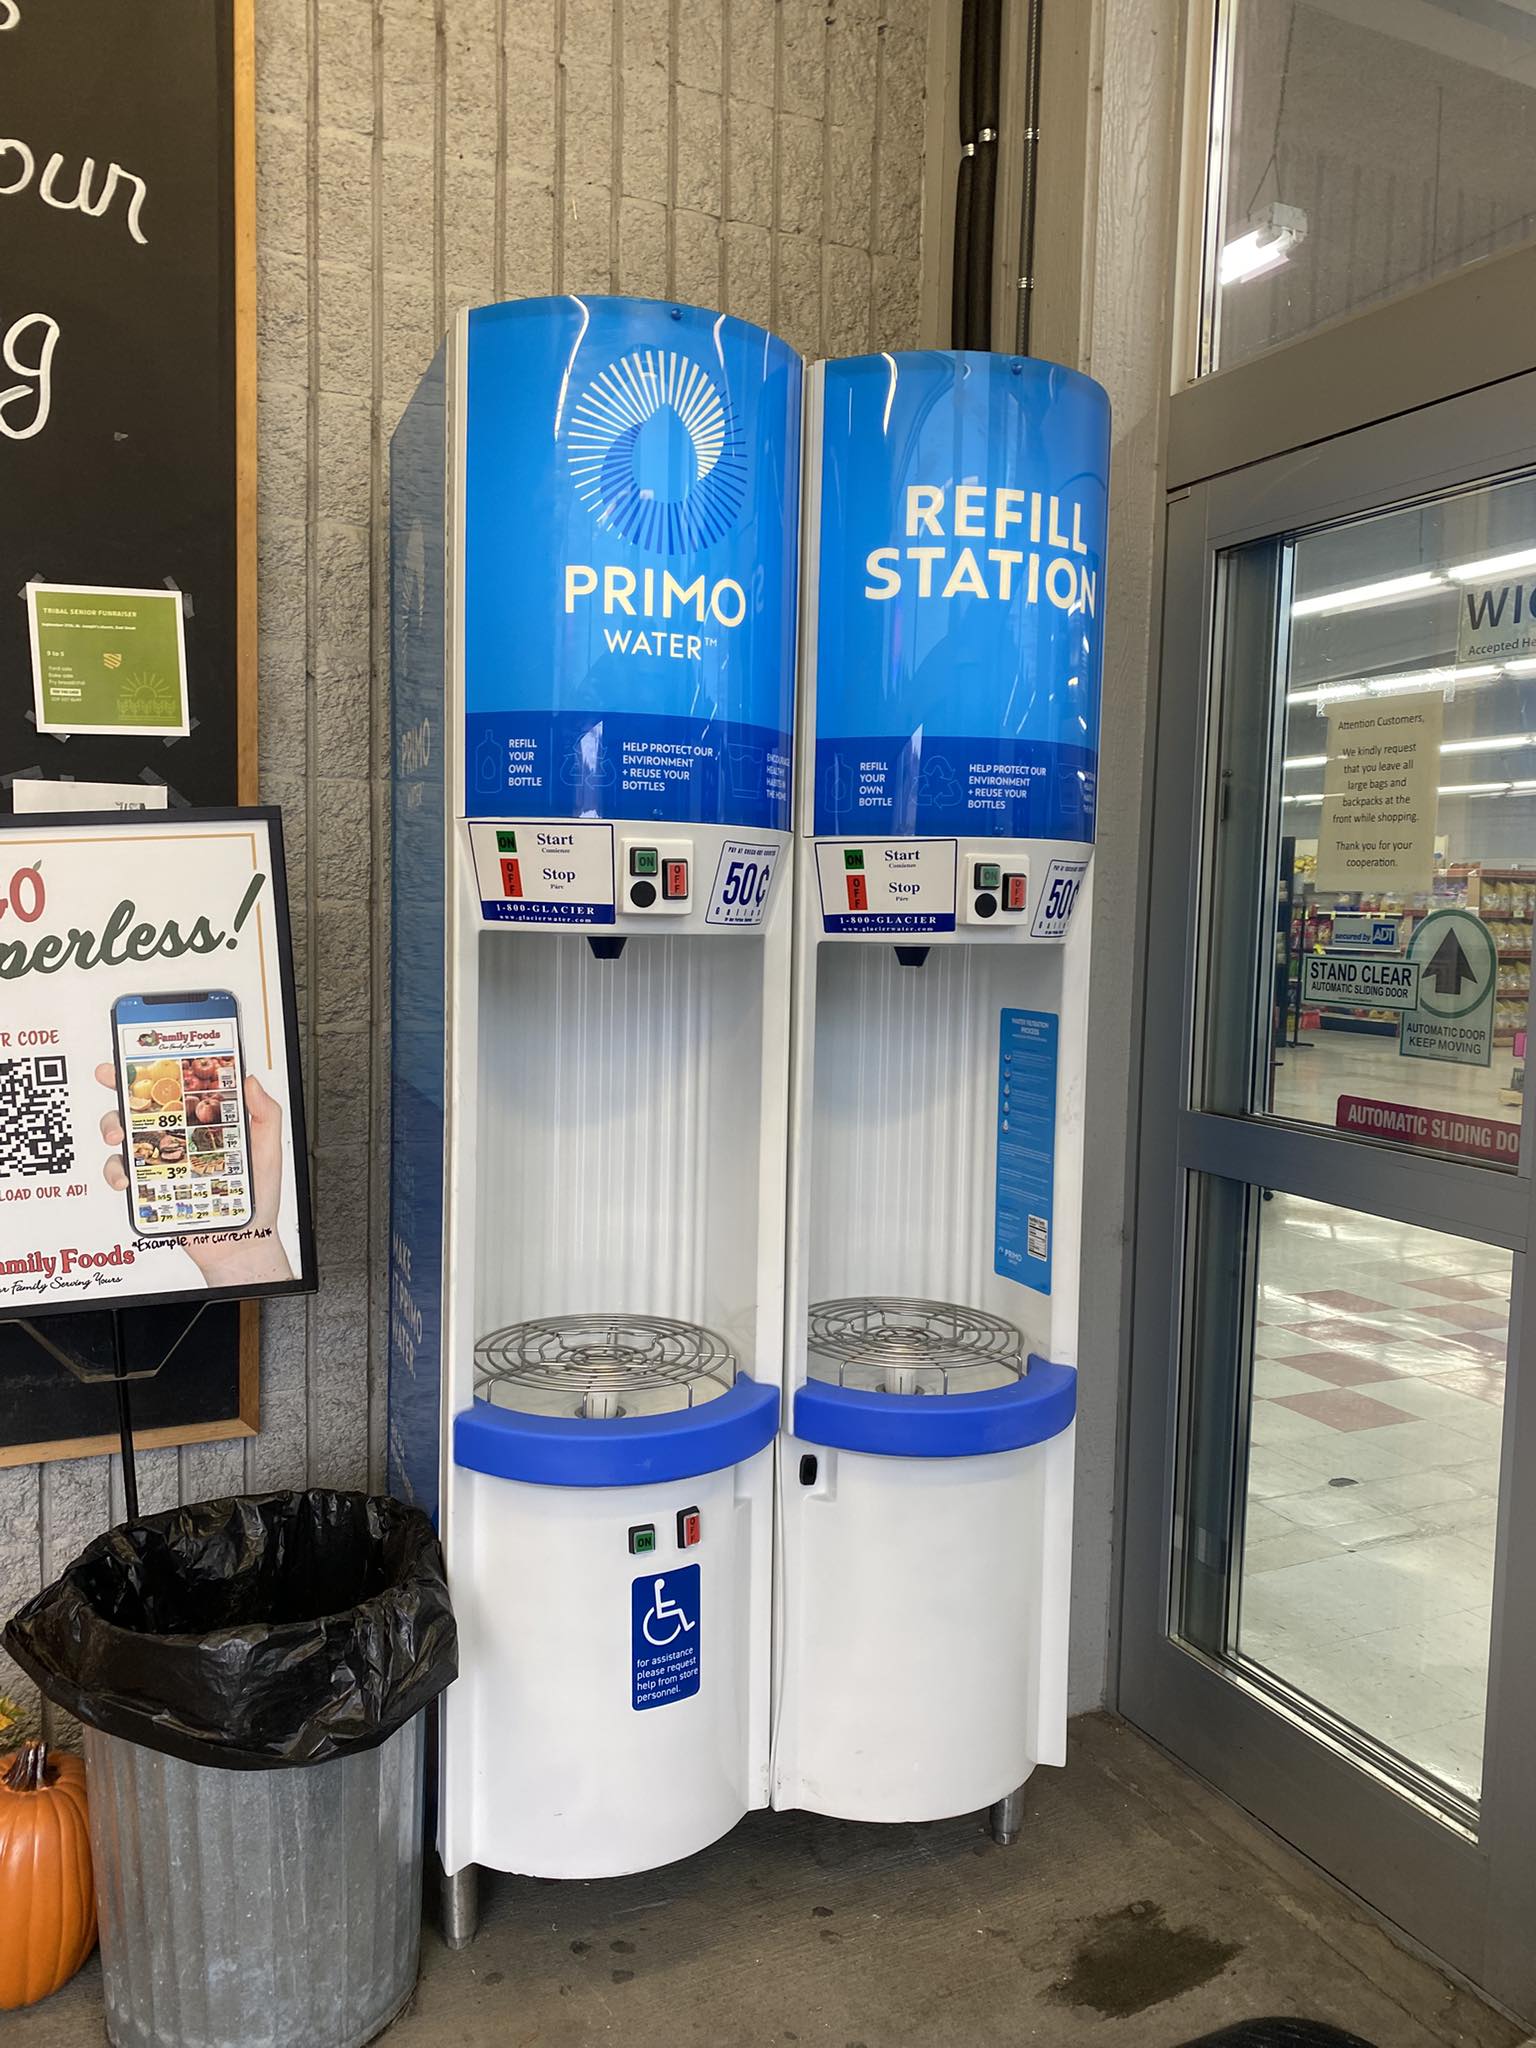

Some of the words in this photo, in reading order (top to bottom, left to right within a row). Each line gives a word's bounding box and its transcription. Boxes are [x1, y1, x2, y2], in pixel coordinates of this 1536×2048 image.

[906, 485, 1088, 555] REFILL
[865, 547, 1096, 619] STATION
[564, 565, 746, 627] PRIMO
[42, 607, 68, 615] TRIBAL
[1468, 638, 1520, 656] Accepted
[1338, 719, 1375, 730] Attention
[1377, 714, 1425, 727] Customers,
[508, 738, 538, 748] REFILL
[622, 741, 648, 752] HELP
[650, 743, 692, 755] PROTECT
[693, 746, 714, 757] OUR
[509, 752, 534, 761] YOUR
[1342, 747, 1357, 757] We
[1358, 745, 1382, 758] kindly
[1383, 743, 1417, 755] request
[622, 754, 694, 768] ENVIRONMENT
[860, 762, 888, 771] REFILL
[1344, 763, 1360, 774] that
[1362, 763, 1377, 775] you
[1378, 761, 1401, 772] leave
[1402, 760, 1413, 769] all
[508, 765, 533, 774] OWN
[630, 768, 662, 779] REUSE
[664, 770, 690, 780] YOUR
[969, 764, 992, 773] HELP
[993, 765, 1030, 775] PROTECT
[1030, 767, 1047, 777] OUR
[508, 777, 543, 787] BOTTLE
[860, 774, 886, 783] YOUR
[968, 776, 1031, 787] ENVIRONMENT
[1348, 780, 1368, 792] large
[1369, 779, 1388, 790] bags
[1390, 777, 1407, 787] and
[622, 781, 666, 792] BOTTLES
[859, 786, 883, 795] OWN
[975, 788, 1003, 798] REUSE
[1004, 789, 1027, 799] YOUR
[859, 797, 893, 807] BOTTLE
[968, 800, 1006, 810] BOTTLES
[1342, 796, 1383, 808] backpacks
[1385, 795, 1394, 805] at
[1395, 795, 1411, 804] the
[1332, 813, 1352, 823] front
[1353, 812, 1376, 823] while
[1377, 812, 1420, 824] shopping.
[499, 837, 516, 849] ON
[536, 833, 574, 846] Start
[1336, 840, 1359, 850] Thank
[1361, 841, 1377, 852] you
[1378, 840, 1391, 850] for
[1392, 841, 1413, 852] your
[639, 856, 654, 867] ON
[847, 855, 863, 866] ON
[884, 850, 920, 861] Start
[1346, 858, 1398, 869] cooperation.
[543, 868, 576, 883] Stop
[984, 871, 998, 881] ON
[723, 861, 770, 907] 50¢
[888, 882, 920, 895] Stop
[0, 867, 46, 923] O
[496, 904, 595, 915] 1-800-GLACIER
[499, 915, 592, 923] www.glacierwater.com
[840, 916, 937, 924] 1-800-GLACIER
[1335, 932, 1362, 941] secured
[1362, 933, 1371, 942] by
[1374, 925, 1395, 943] ADT
[1310, 961, 1357, 981] STAND
[1361, 965, 1412, 986] CLEAR
[1311, 981, 1353, 993] AUTOMATIC
[1354, 984, 1385, 997] SLIDING
[1385, 987, 1408, 998] DOOR
[17, 1029, 60, 1046] CODE
[156, 1031, 189, 1044] Family
[190, 1030, 221, 1042] Foods
[1407, 1023, 1458, 1038] AUTOMATIC
[1459, 1027, 1486, 1041] DOOR
[1408, 1035, 1437, 1049] KEEP
[1438, 1039, 1481, 1055] MOVING
[158, 1114, 182, 1127] 89¢
[1347, 1103, 1428, 1136] AUTOMATIC
[1431, 1118, 1491, 1148] SLIDING
[36, 1186, 61, 1199] OUR
[66, 1184, 88, 1197] AD!
[193, 1236, 209, 1245] not
[212, 1230, 252, 1244] current
[60, 1244, 136, 1274] Foods
[11, 1278, 48, 1295] Family
[49, 1275, 92, 1290] Serving
[92, 1271, 123, 1285] Yours
[638, 1537, 652, 1548] ON
[637, 1658, 649, 1668] for
[652, 1647, 694, 1666] assistance
[637, 1667, 665, 1681] please
[667, 1657, 697, 1675] request
[637, 1678, 656, 1693] help
[658, 1675, 678, 1687] from
[679, 1667, 699, 1681] store
[637, 1686, 681, 1704] personnel.
